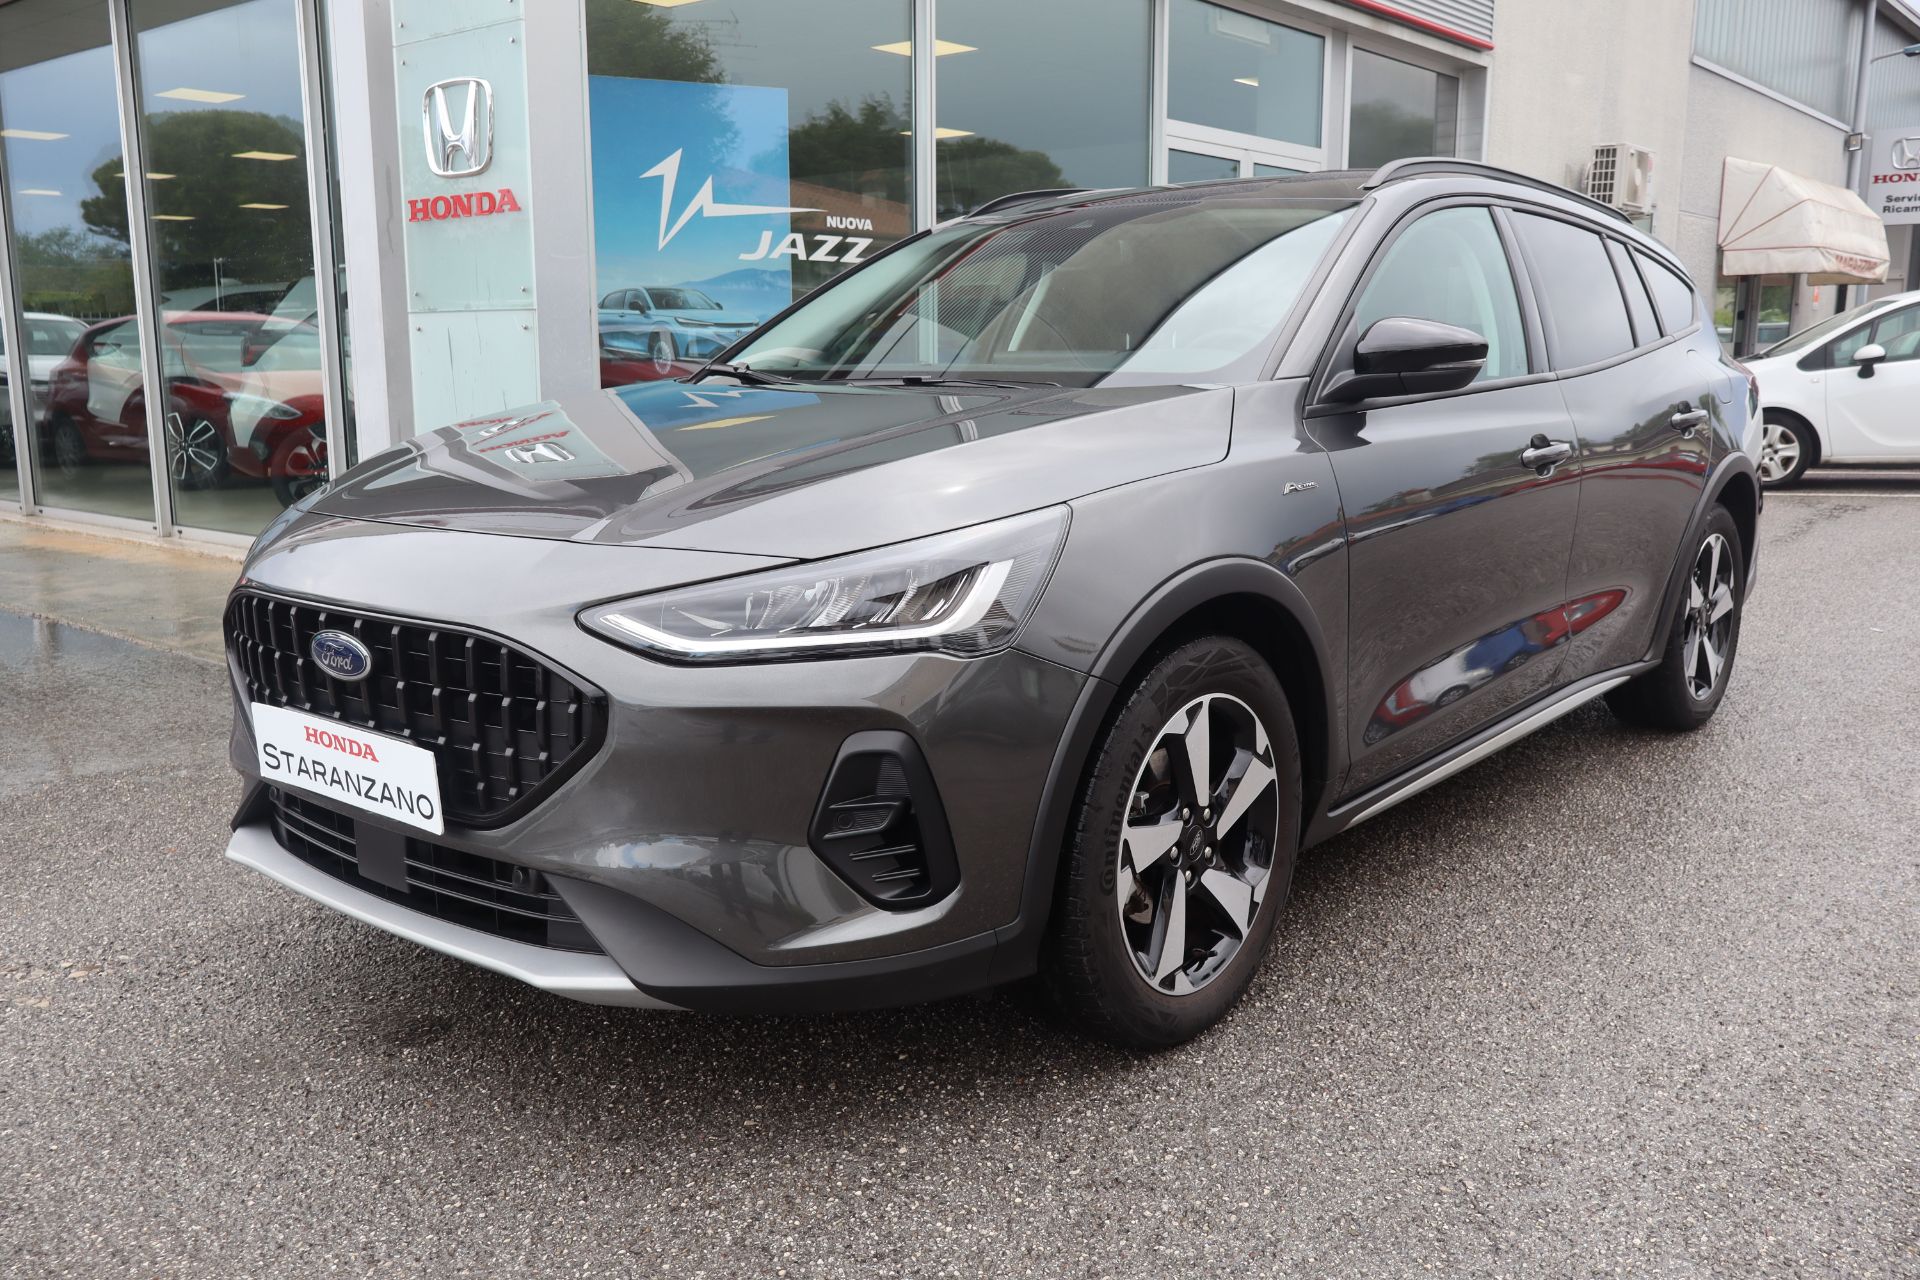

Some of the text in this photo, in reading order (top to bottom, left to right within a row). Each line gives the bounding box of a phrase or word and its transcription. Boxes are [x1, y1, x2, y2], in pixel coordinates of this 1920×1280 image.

[1872, 173, 1920, 185] HON
[408, 188, 521, 222] HONDA
[1885, 193, 1920, 203] Servi
[826, 215, 873, 231] NUOVA
[738, 230, 873, 263] JAZZ
[321, 642, 353, 670] Ford
[304, 725, 379, 763] HONDA
[263, 742, 434, 820] STARANZANO
[1101, 737, 1148, 895] Continental
